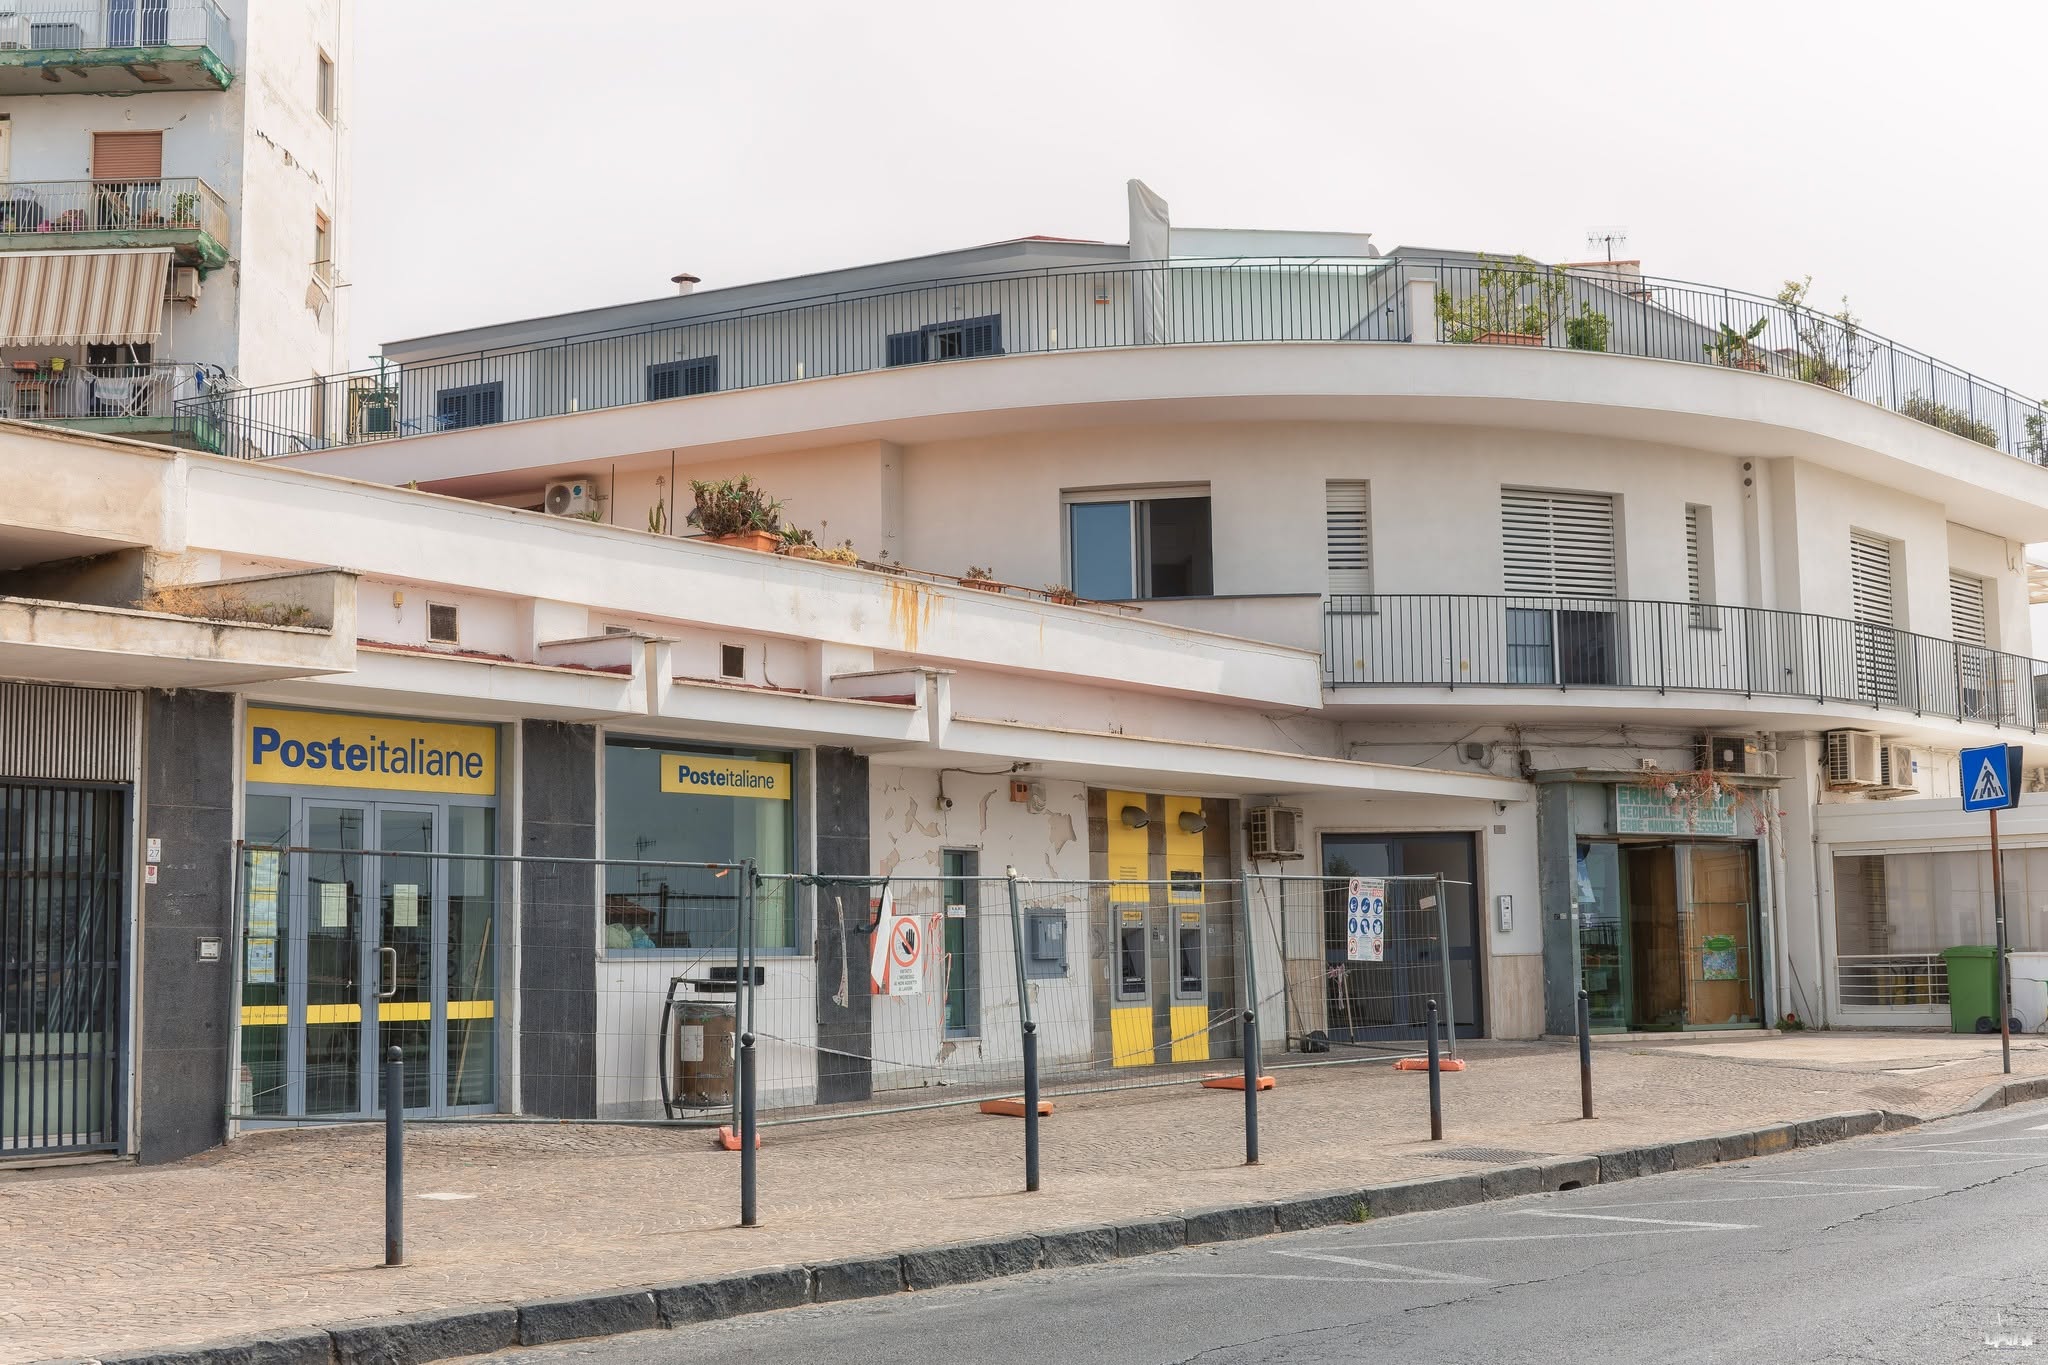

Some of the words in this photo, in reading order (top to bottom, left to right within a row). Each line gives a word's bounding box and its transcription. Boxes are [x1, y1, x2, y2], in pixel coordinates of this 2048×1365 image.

[252, 726, 483, 779] Posteitaliane
[678, 764, 774, 790] Posteitaliane
[149, 849, 160, 858] 27
